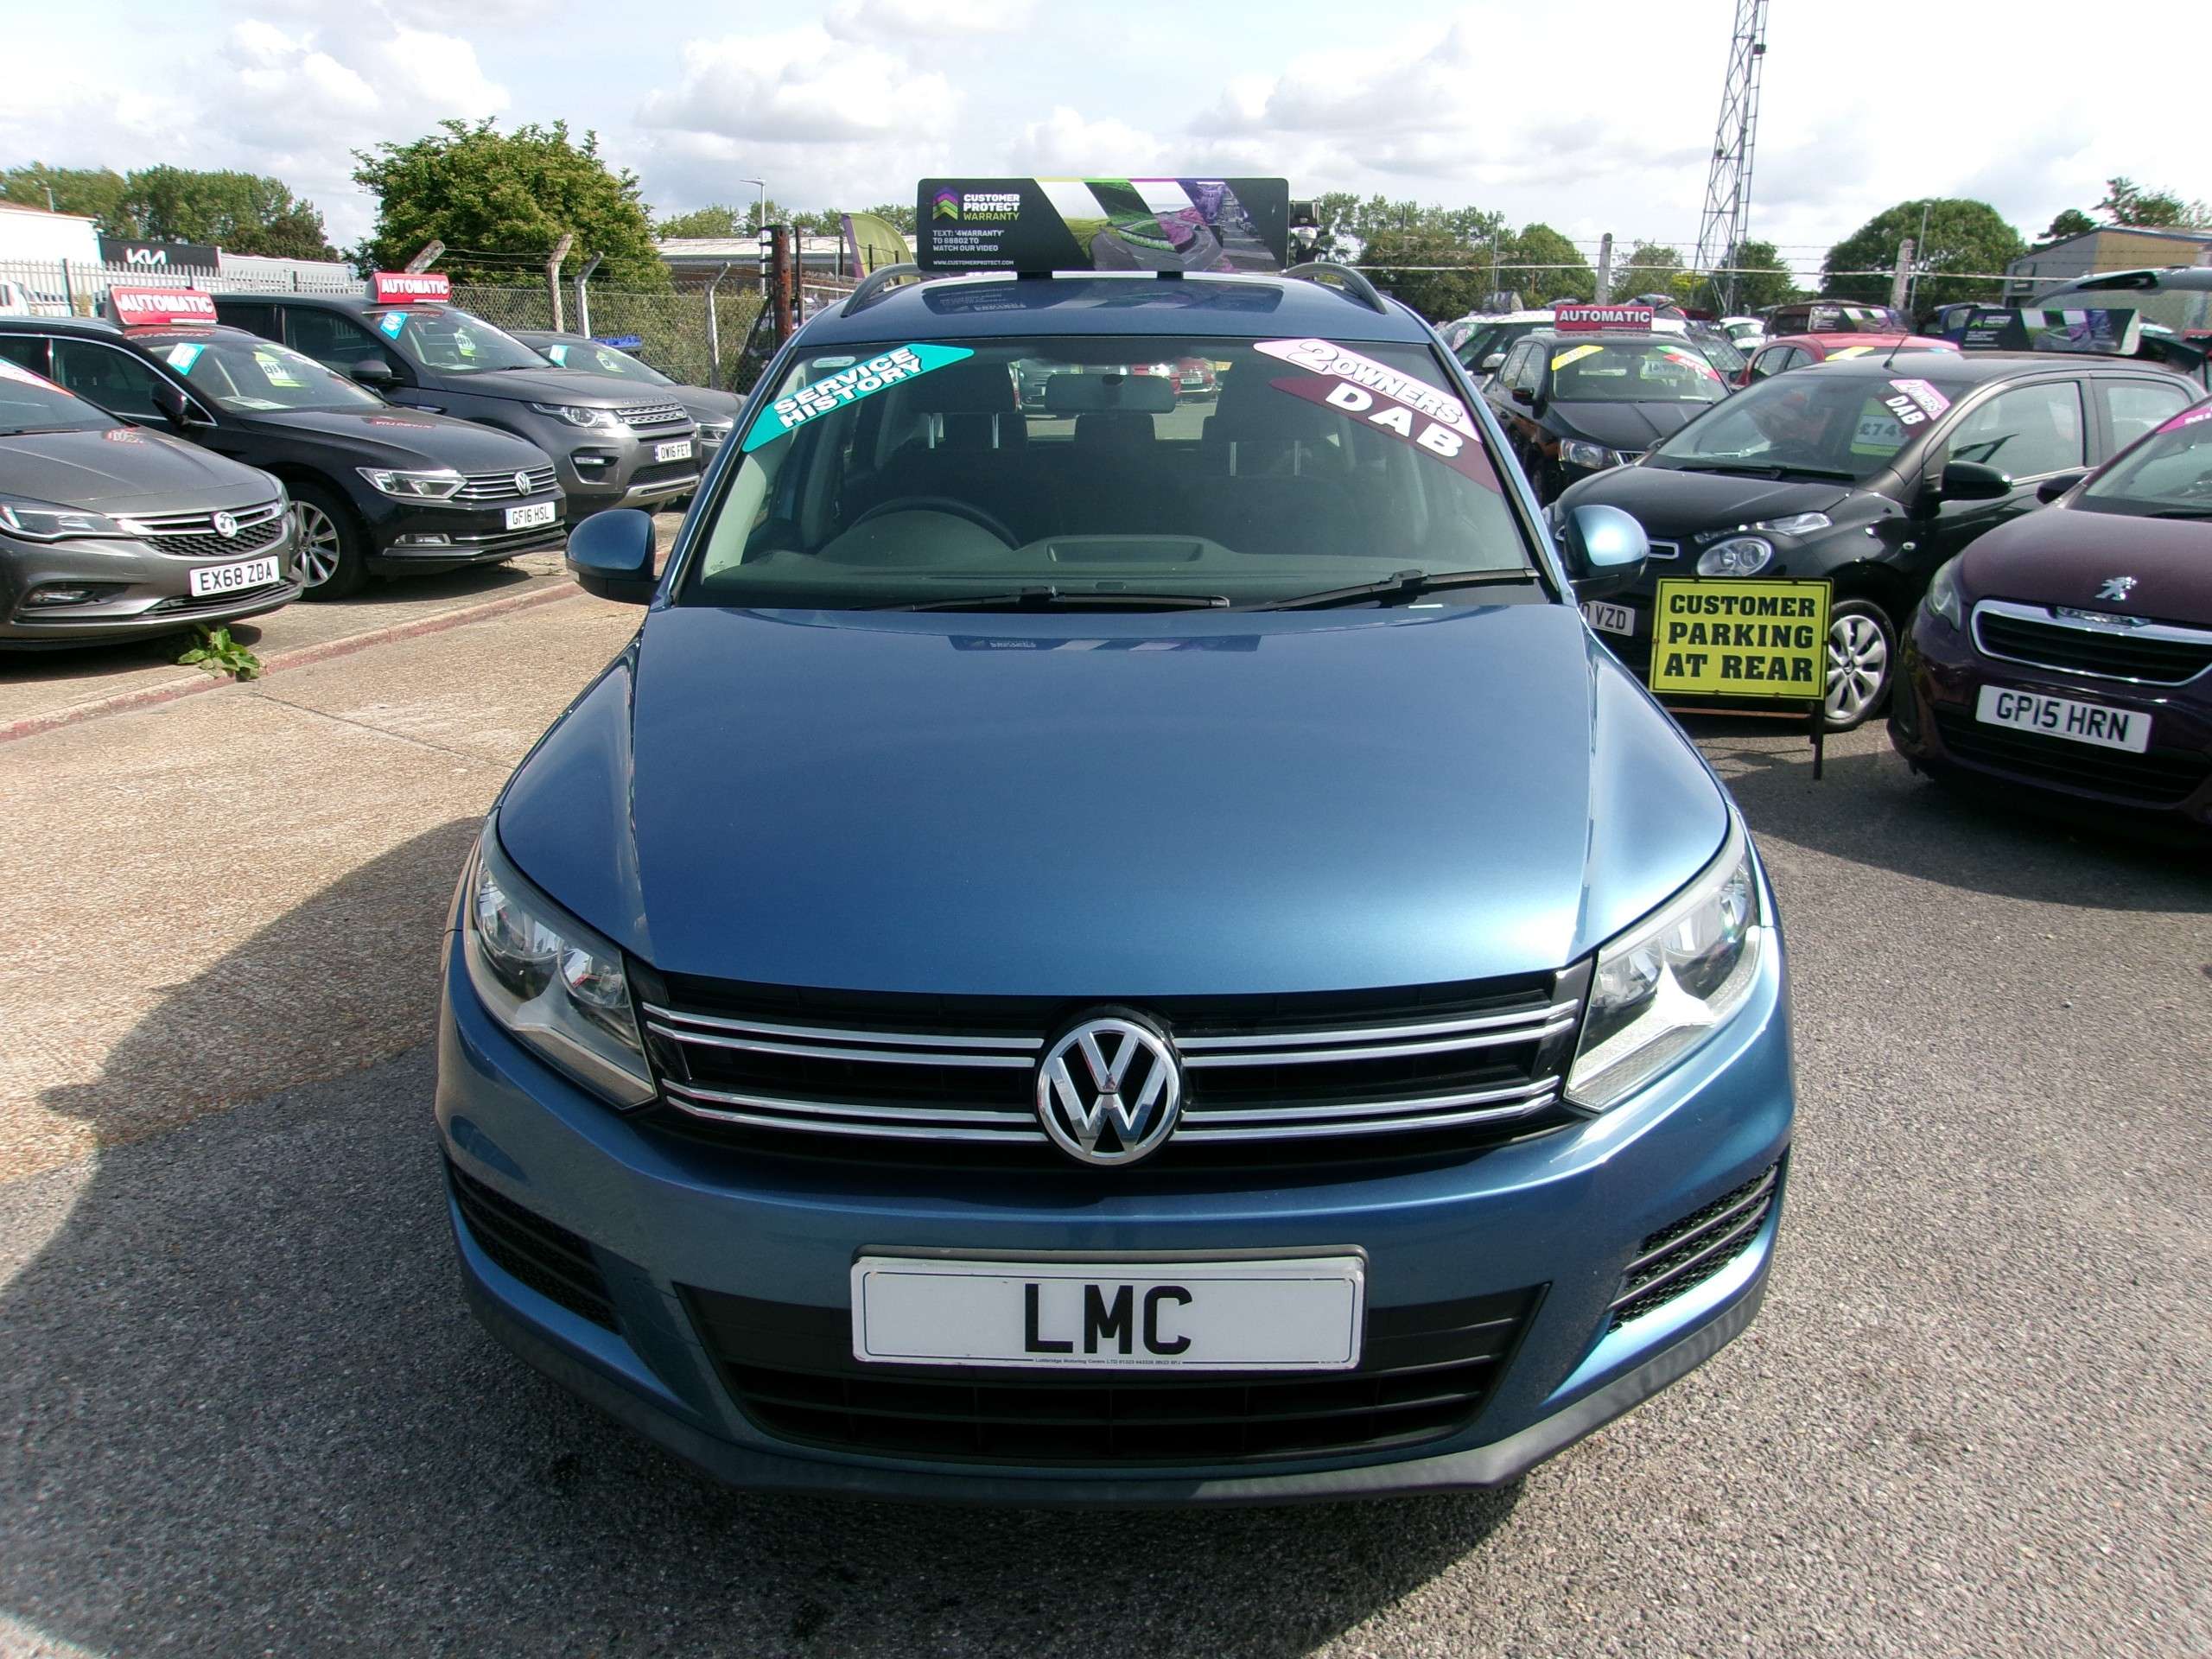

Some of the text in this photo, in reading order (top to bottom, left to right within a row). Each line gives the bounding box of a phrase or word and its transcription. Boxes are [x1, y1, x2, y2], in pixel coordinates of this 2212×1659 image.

[963, 194, 1020, 202] CUSTOMER
[963, 203, 1020, 212] PROTECT
[963, 213, 1020, 221] WARRANTY
[383, 278, 448, 295] AUTOMATIC
[118, 294, 213, 314] AUTOMATIC
[1559, 310, 1651, 322] AUTOMATIC
[773, 347, 918, 416] SERVICE
[779, 357, 925, 429] HISTORY
[1325, 382, 1465, 457] DAB
[1885, 395, 1926, 425] DAB
[534, 505, 550, 521] HSL
[200, 568, 243, 591] EX68
[1669, 594, 1815, 617] CUSTOMER
[1596, 606, 1626, 630] VZD
[1668, 622, 1814, 648] PARKING
[1663, 653, 1813, 682] AT REAR
[1996, 692, 2129, 742] GP15 HRN
[1025, 1283, 1192, 1355] LMC
